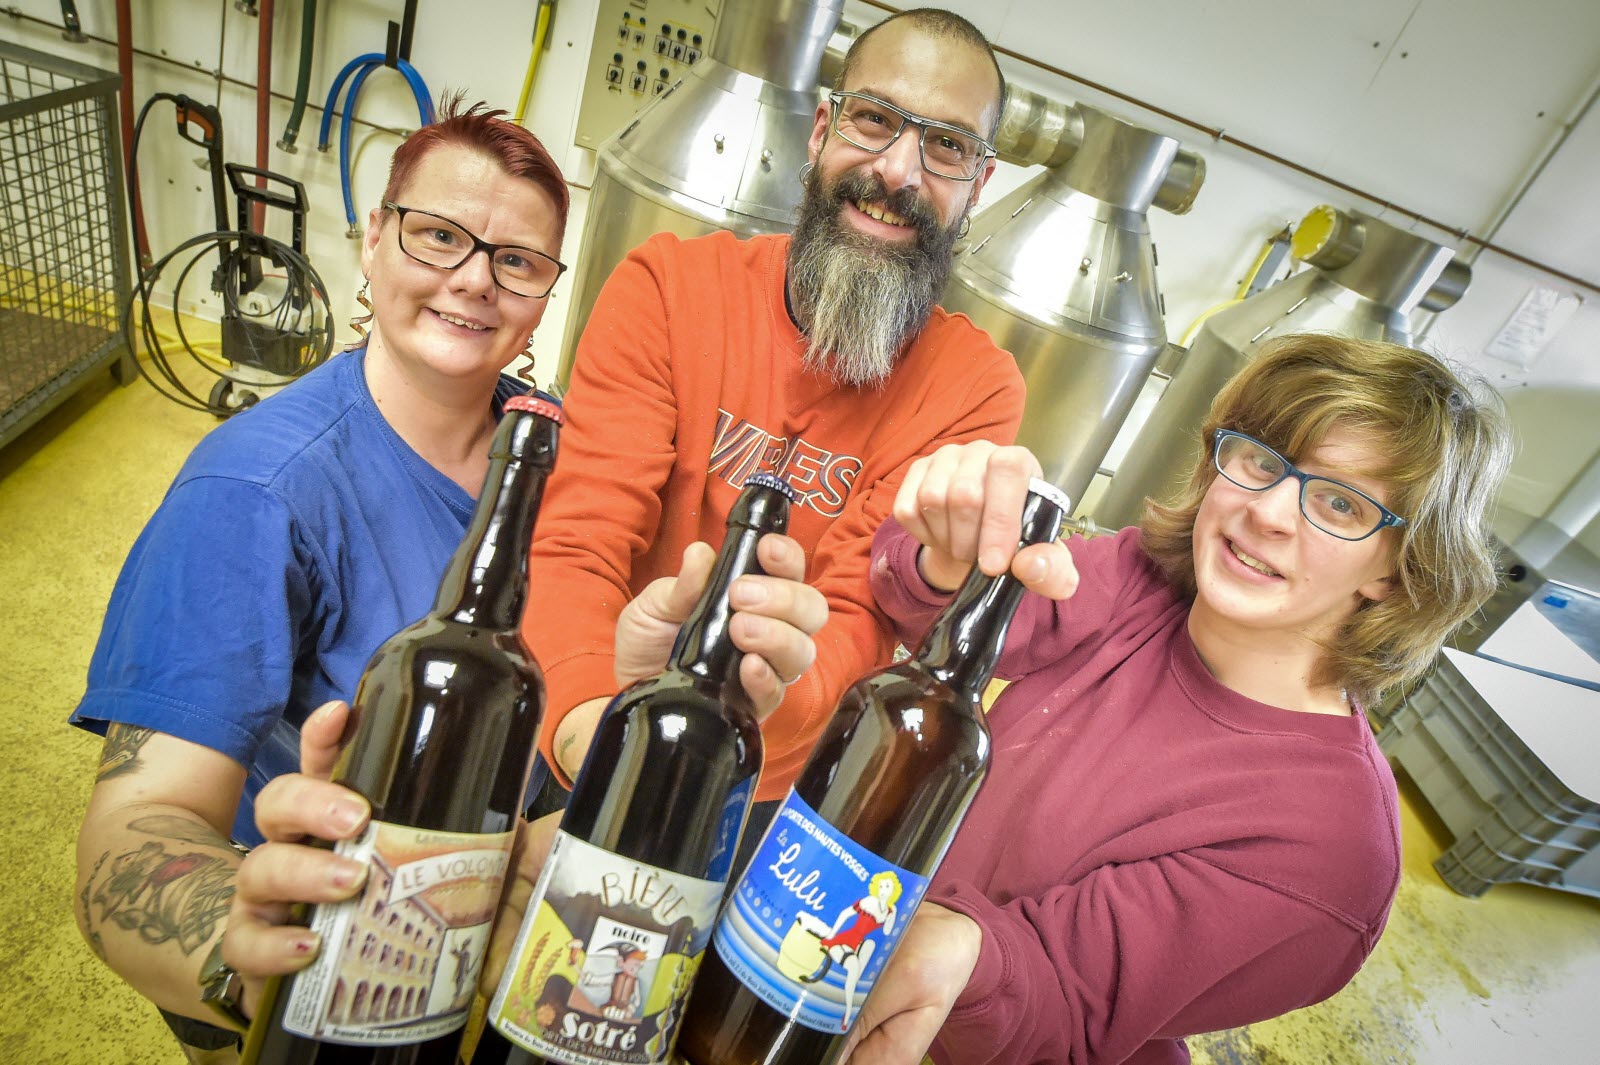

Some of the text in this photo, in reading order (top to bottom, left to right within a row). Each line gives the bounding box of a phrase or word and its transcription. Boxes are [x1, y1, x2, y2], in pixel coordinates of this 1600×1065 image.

[708, 408, 863, 517] VIBES
[802, 818, 815, 834] DES
[813, 829, 843, 857] HAUTES
[838, 849, 870, 882] VOSGES
[401, 866, 425, 890] LE
[769, 842, 827, 911] Lulu
[612, 926, 651, 944] noire
[560, 1012, 637, 1051] Sotré
